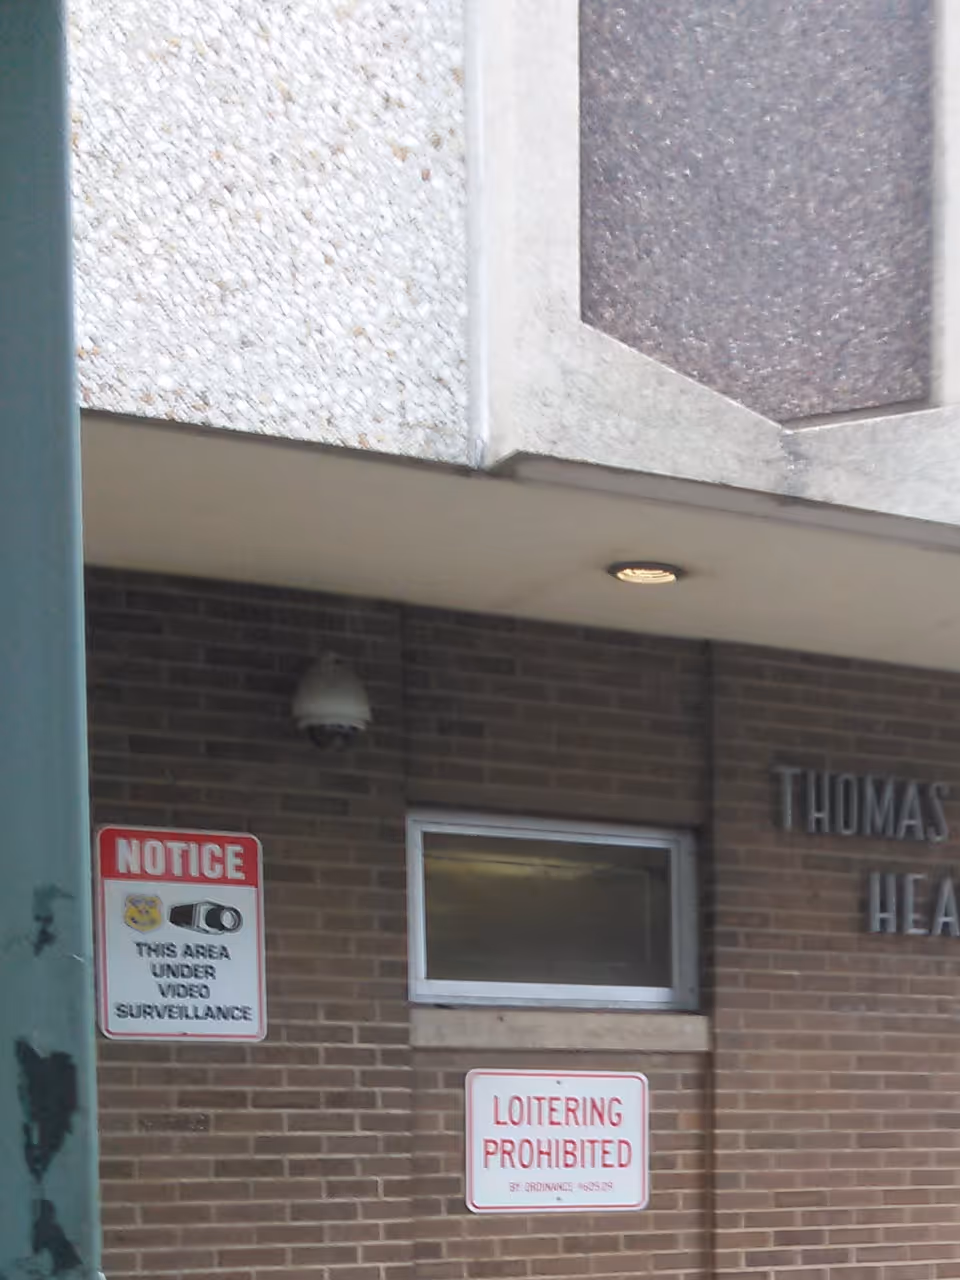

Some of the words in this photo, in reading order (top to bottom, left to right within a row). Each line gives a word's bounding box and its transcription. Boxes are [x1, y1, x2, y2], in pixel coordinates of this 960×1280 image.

[774, 765, 950, 843] THOMAS
[115, 837, 246, 880] NOTICE
[135, 942, 177, 958] THIS
[183, 944, 231, 960] AREA
[152, 963, 216, 980] UNDER
[158, 983, 210, 999] VIDEO
[115, 1003, 253, 1021] SURVEILLANCE
[493, 1095, 623, 1127] LOITERING
[483, 1138, 632, 1169] PROHIBITED
